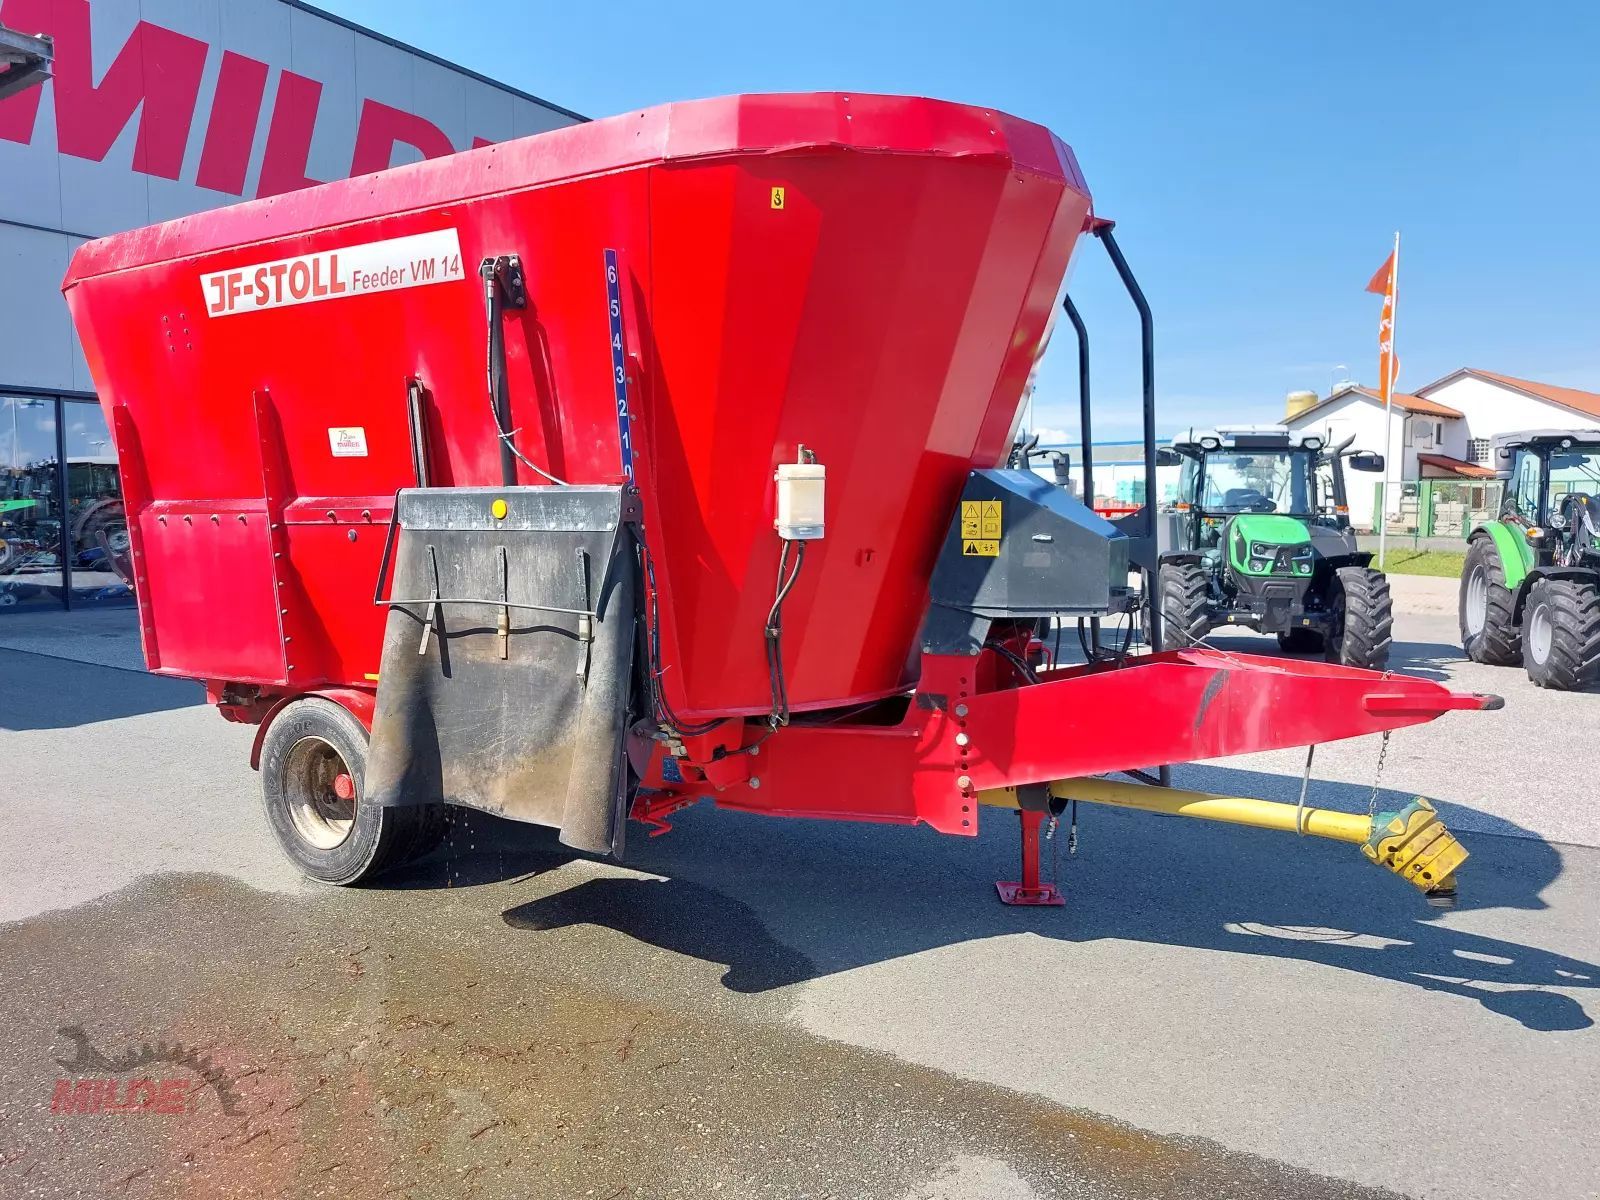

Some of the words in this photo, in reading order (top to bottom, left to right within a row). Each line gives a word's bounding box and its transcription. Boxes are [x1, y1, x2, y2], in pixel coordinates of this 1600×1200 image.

[0, 0, 500, 199] MILD
[210, 254, 346, 314] JF-STOLL
[353, 265, 406, 290] Feeder
[410, 257, 436, 282] VM
[441, 253, 460, 277] 14
[607, 265, 616, 284] 6
[611, 299, 619, 317] 5
[613, 332, 621, 350] 4
[616, 365, 624, 384] 3
[619, 399, 627, 416] 2
[622, 431, 629, 449] 1
